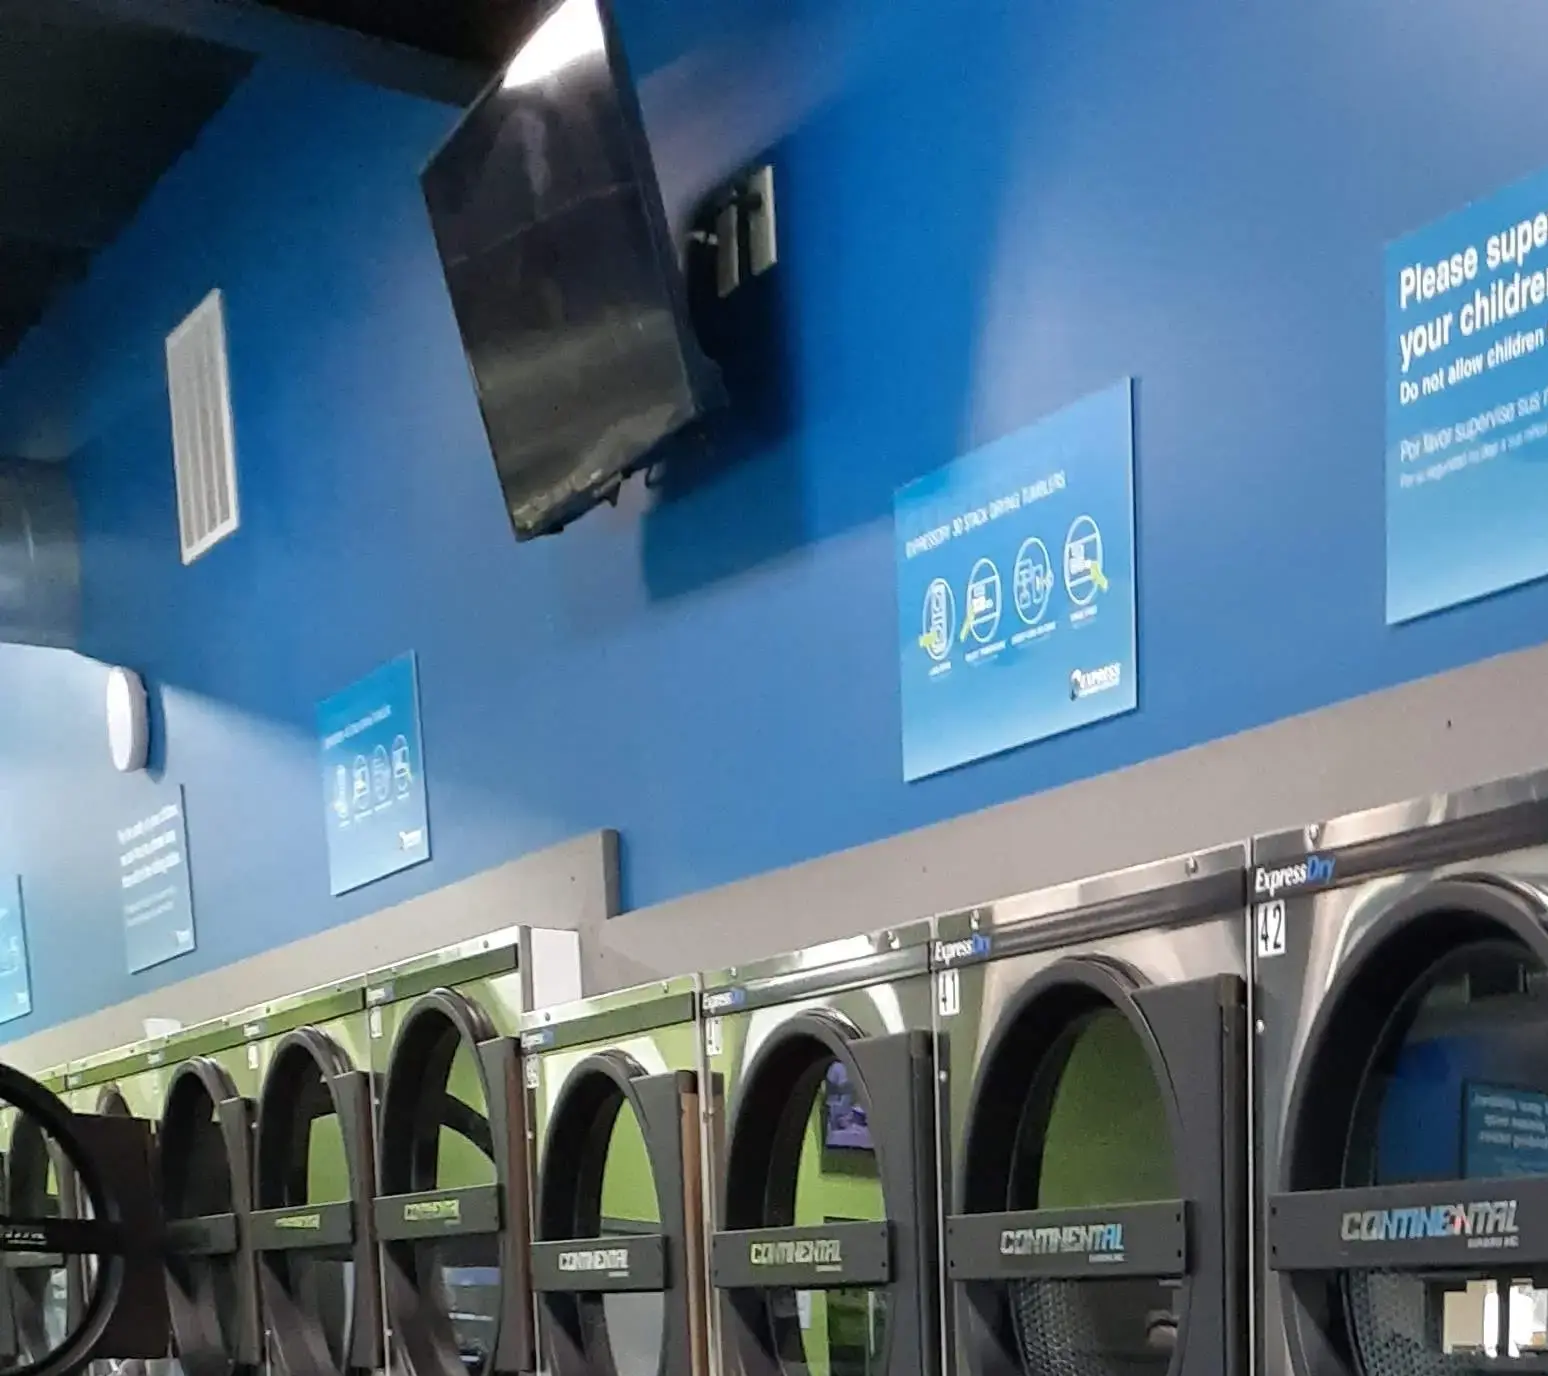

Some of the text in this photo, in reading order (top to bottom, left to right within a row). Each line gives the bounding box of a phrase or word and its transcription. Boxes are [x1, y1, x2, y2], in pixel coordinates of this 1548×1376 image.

[1400, 246, 1478, 310] Please
[1400, 312, 1453, 373] your
[1400, 379, 1419, 406] Do
[1422, 367, 1445, 395] not
[1448, 353, 1483, 385] allow
[1487, 327, 1544, 369] children
[1400, 439, 1420, 463] Por
[1454, 402, 1515, 443] supervise
[1517, 390, 1541, 418] sus
[1255, 854, 1336, 897] ExpressDry
[1261, 904, 1282, 952] 42
[1000, 1223, 1124, 1255] CONTINENTAL
[1341, 1200, 1519, 1241] CONTINENTAL
